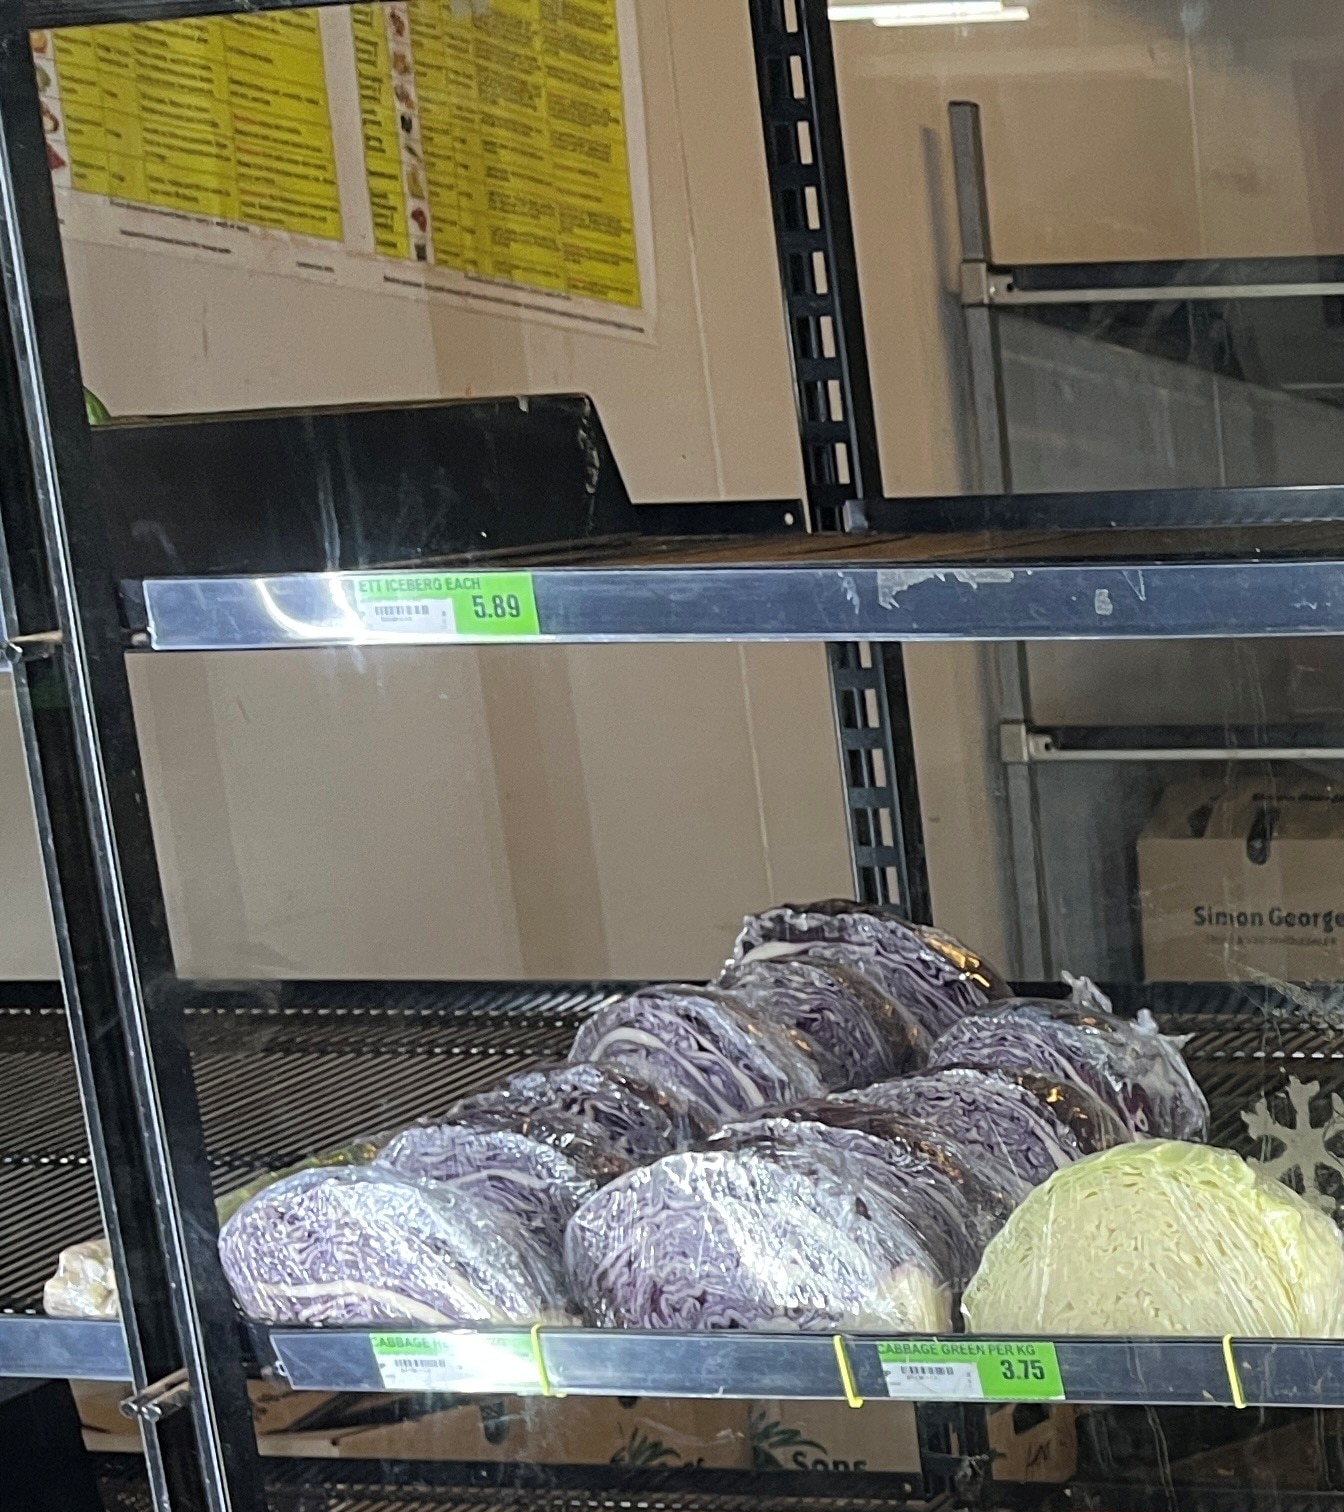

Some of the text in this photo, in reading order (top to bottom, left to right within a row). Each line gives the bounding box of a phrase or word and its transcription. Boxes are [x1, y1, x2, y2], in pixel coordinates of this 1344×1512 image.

[386, 578, 442, 592] ICEBERG
[446, 577, 481, 591] EACH
[472, 594, 520, 619] 5.89
[1194, 906, 1263, 929] Simon
[878, 1343, 1036, 1356] CABBAGE GREEN PER KG
[1000, 1359, 1045, 1380] 3.75
